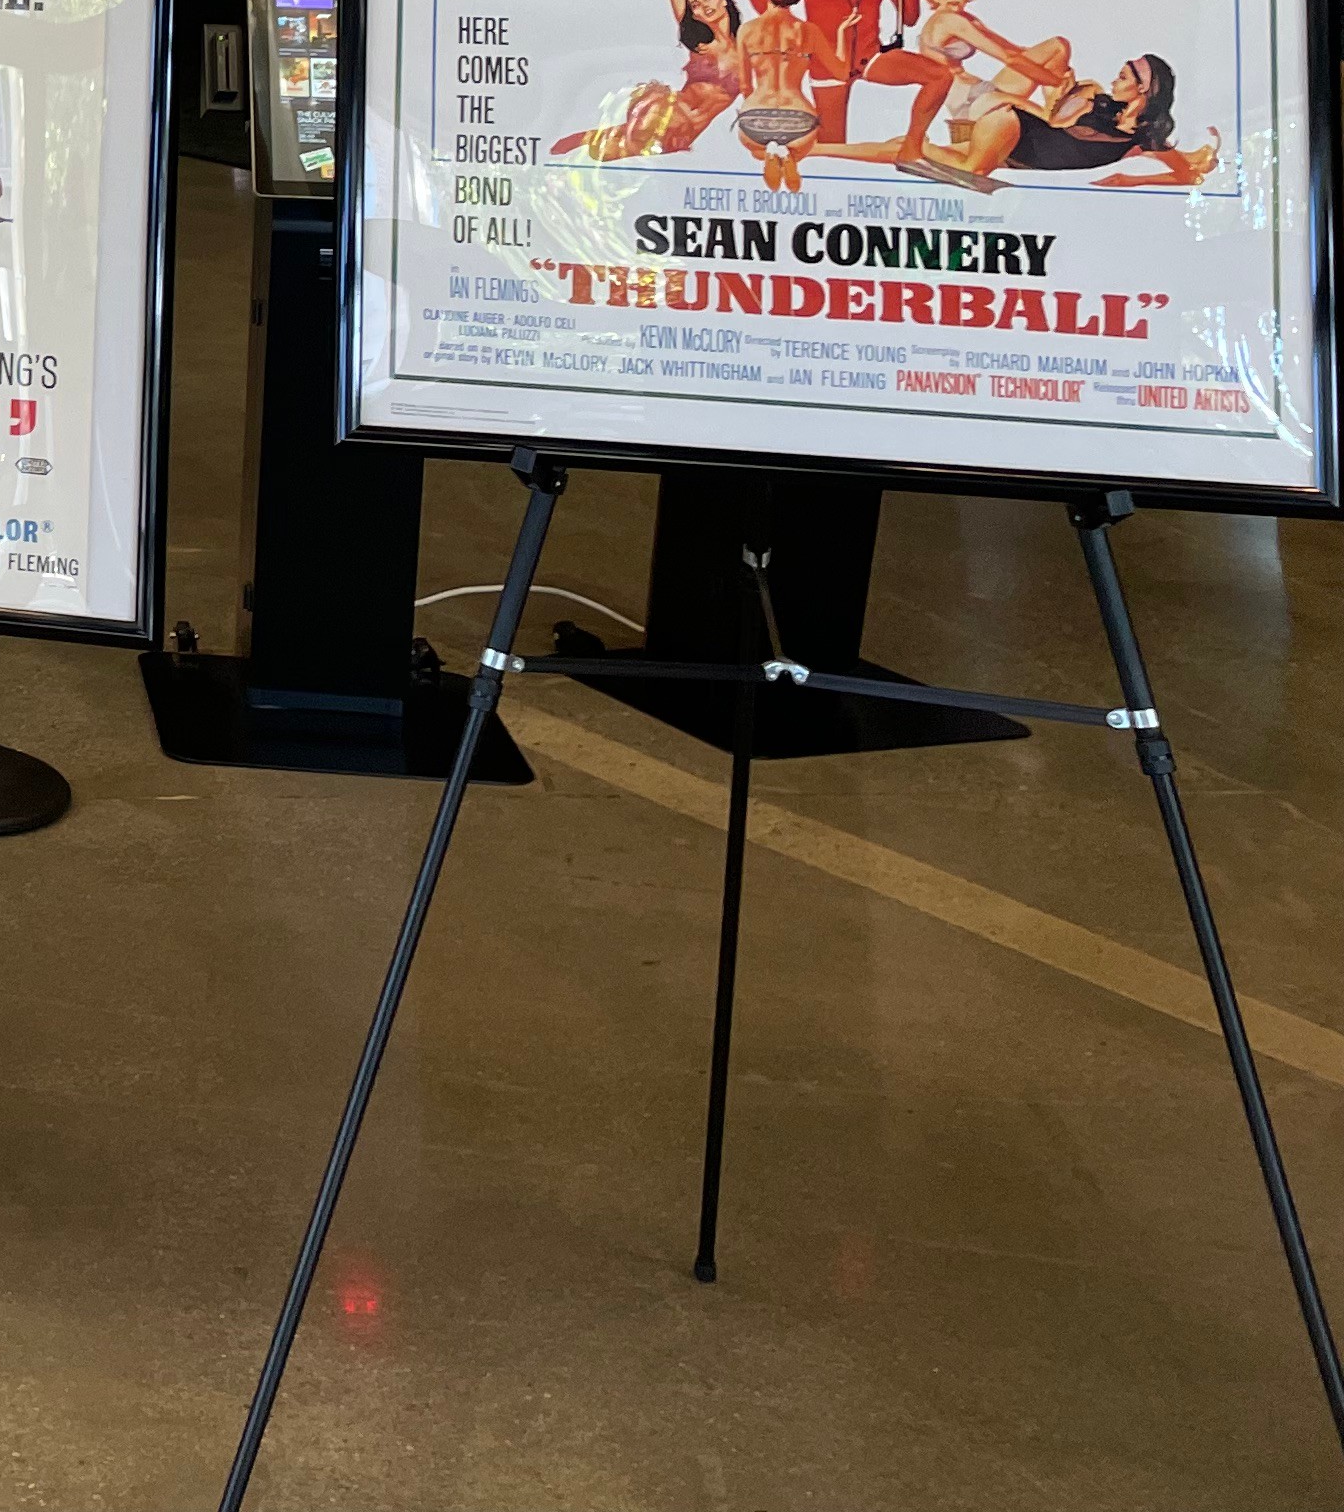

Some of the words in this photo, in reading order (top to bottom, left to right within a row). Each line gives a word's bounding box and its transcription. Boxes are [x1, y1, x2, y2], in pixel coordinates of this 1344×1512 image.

[458, 16, 509, 46] HERE
[457, 55, 529, 86] COMES
[457, 95, 495, 124] THE
[455, 134, 541, 166] BIGGEST
[455, 175, 512, 206] BOND
[683, 187, 733, 212] ALBERT
[752, 190, 818, 216] BROCCOLI
[846, 195, 891, 220] HARRY
[894, 197, 964, 223] SALTZMAN
[453, 215, 479, 244] OF
[486, 217, 532, 247] ALL!
[634, 214, 777, 264] SEAN
[792, 223, 1057, 276] CONNERY
[895, 370, 976, 396] PANAVISION
[990, 374, 1081, 403] TECHNICOLOR
[1137, 386, 1188, 410] UNITED
[1193, 389, 1250, 413] ARTISTS
[7, 553, 80, 577] FLEMING
